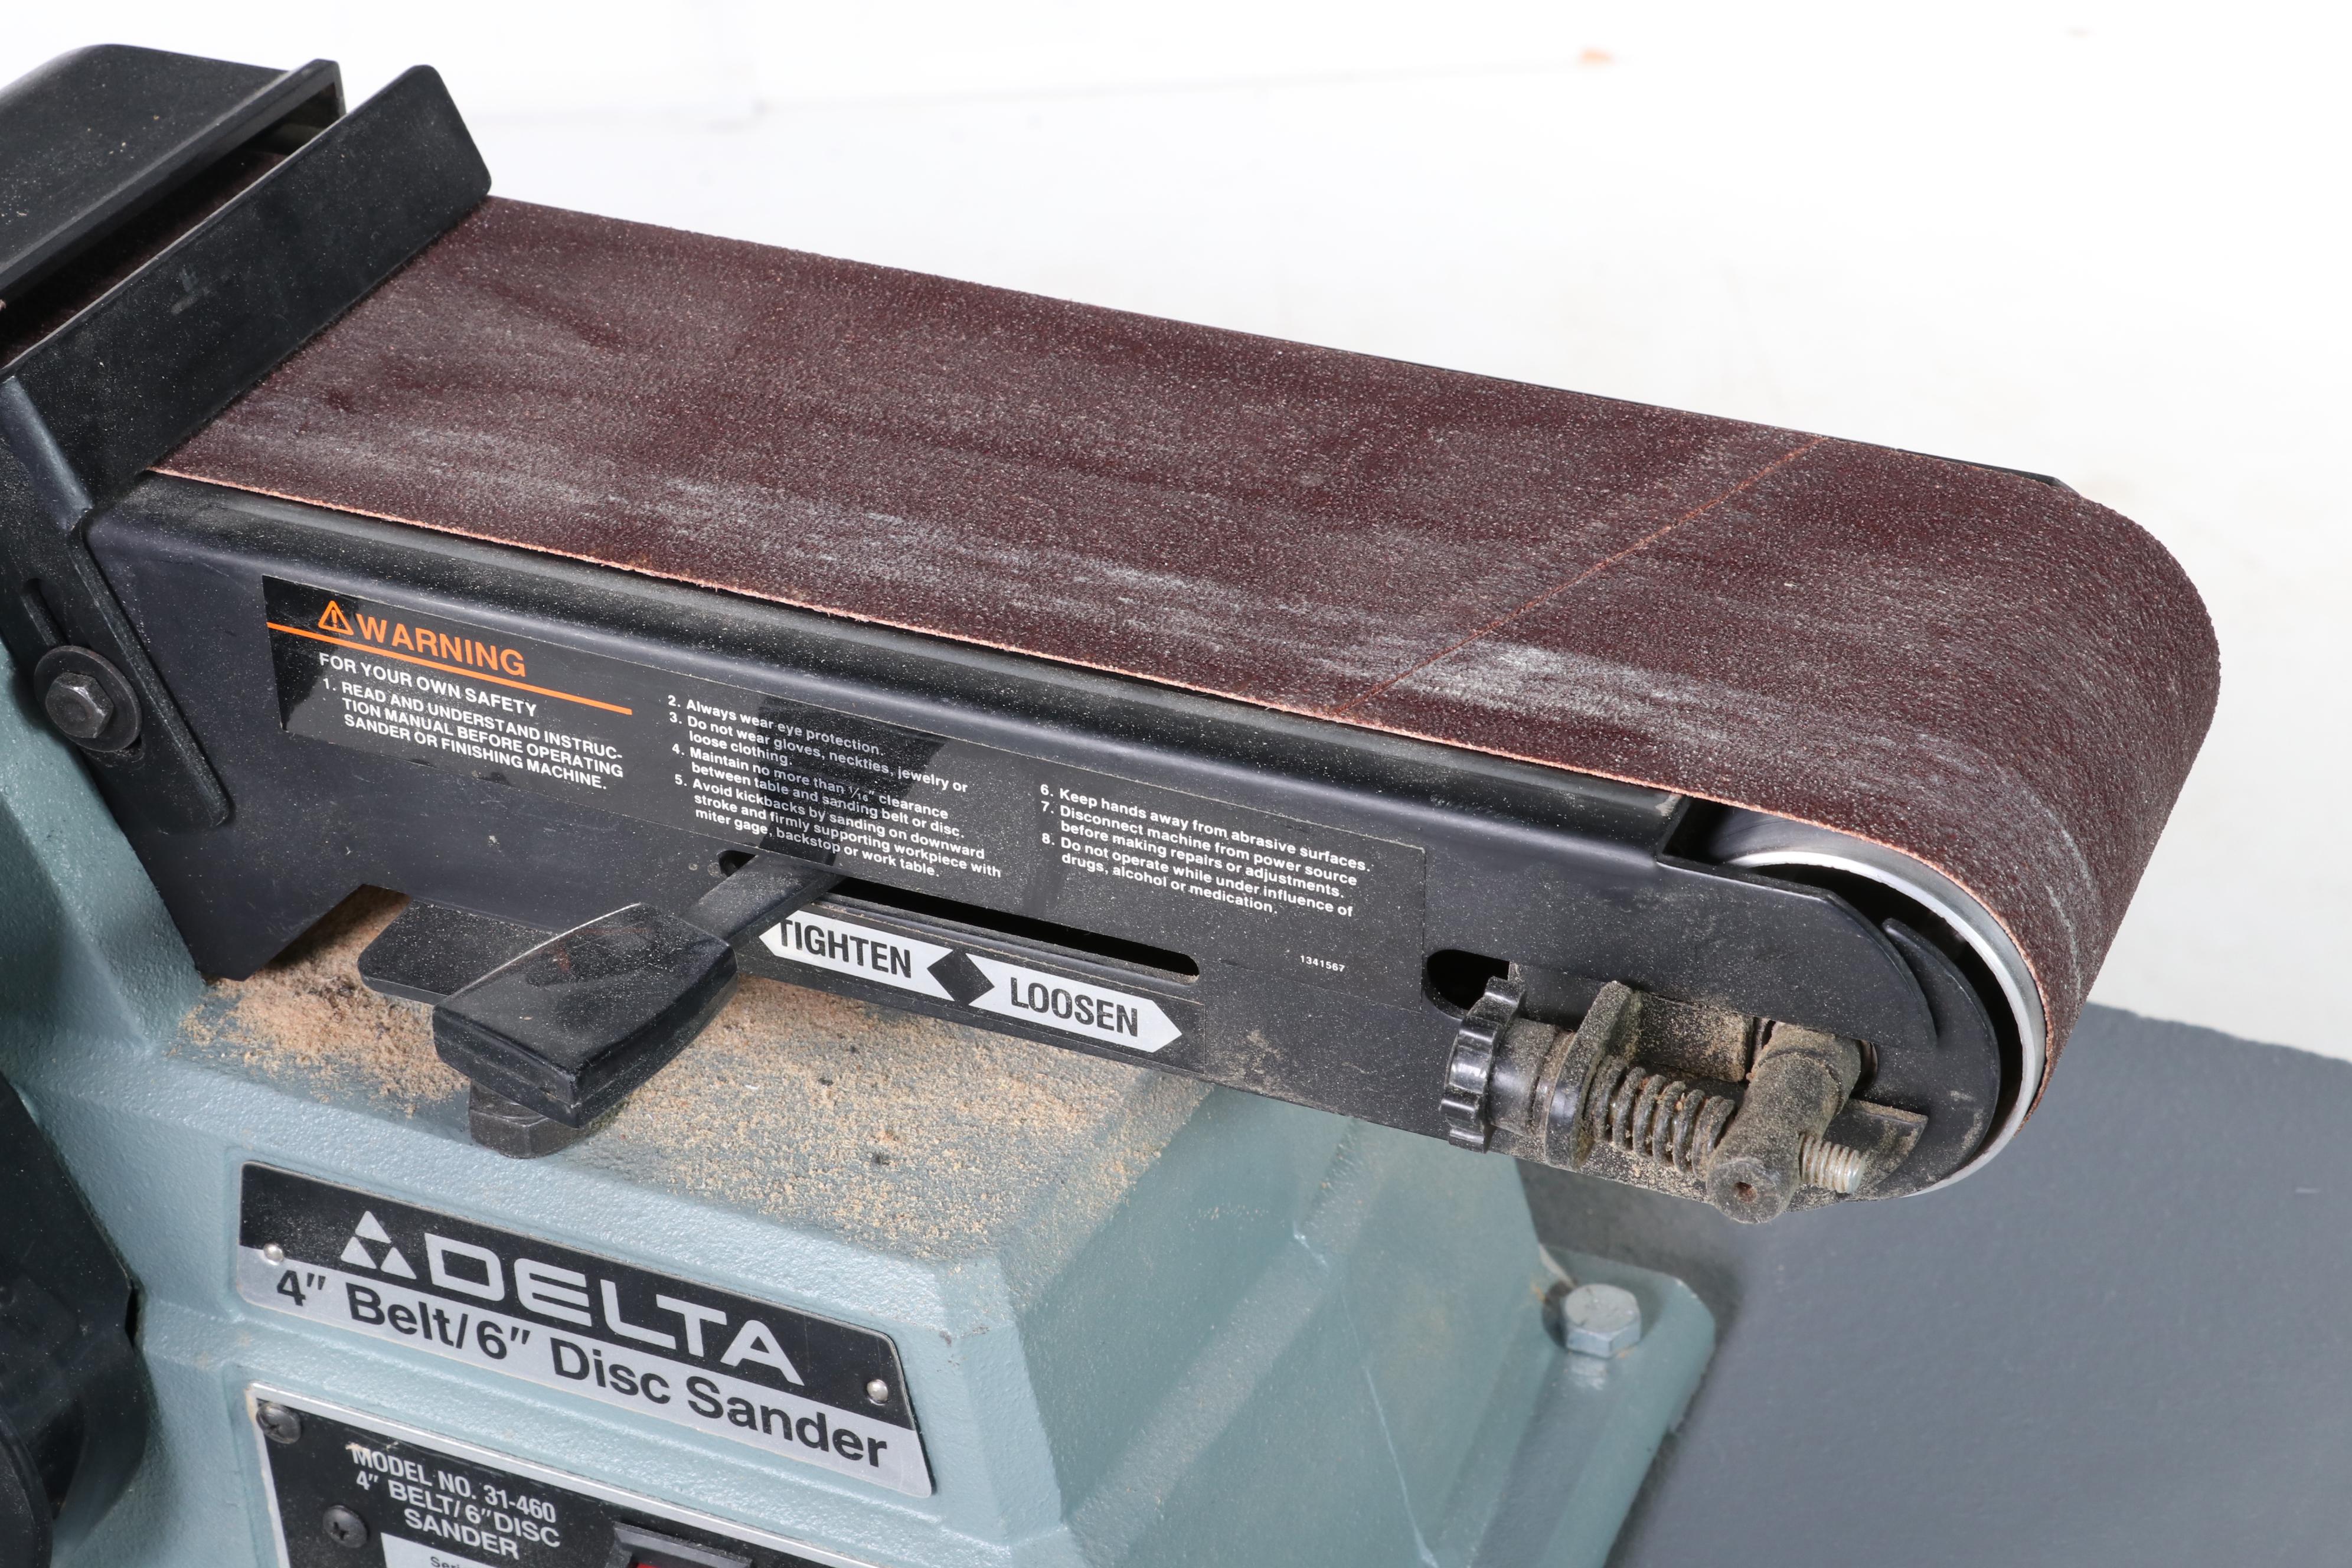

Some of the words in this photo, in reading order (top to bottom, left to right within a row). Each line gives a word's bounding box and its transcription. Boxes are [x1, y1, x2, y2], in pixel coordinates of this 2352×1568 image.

[357, 613, 525, 677] WARNING
[319, 652, 357, 674] FOR
[360, 662, 412, 687] YOUR
[416, 677, 461, 699] OWN
[465, 688, 537, 717] SAFETY
[323, 678, 336, 691] 1.
[342, 682, 386, 703] READ
[390, 694, 424, 711] AND
[428, 703, 540, 740] UNDERSTAND
[544, 730, 622, 759] INSTRUC-
[342, 697, 381, 718] TION
[385, 708, 454, 736] MANUAL
[458, 726, 524, 753] BEFORE
[527, 743, 623, 778] OPERATING
[344, 714, 410, 741] SANDER
[414, 732, 437, 748] OR
[442, 737, 523, 769] FINISHING
[527, 759, 606, 789] MACHINE.
[668, 695, 681, 707] 2.
[687, 699, 737, 721] Always
[740, 713, 773, 729] wear
[778, 723, 802, 736] eye
[806, 729, 884, 756] protection.
[669, 711, 682, 724] 3.
[687, 716, 707, 729] Do
[710, 723, 733, 736] not
[737, 729, 770, 744] wear
[774, 737, 825, 760] gloves,
[829, 750, 894, 776] neckties,
[898, 766, 949, 790] jewelry
[952, 781, 968, 792] or
[689, 730, 727, 750] loose
[731, 740, 792, 766] clothing.
[672, 743, 684, 756] 4.
[690, 746, 749, 770] Maintain
[753, 763, 770, 776] no
[774, 769, 809, 786] more
[814, 777, 844, 794] than
[878, 794, 948, 819] clearance
[675, 774, 687, 786] 5.
[692, 779, 732, 798] Avoid
[736, 788, 805, 815] kickbacks
[809, 806, 826, 822] by
[829, 813, 885, 837] sanding
[889, 828, 907, 840] on
[910, 832, 985, 860] downward
[692, 762, 750, 786] between
[754, 778, 789, 795] table
[793, 787, 818, 802] and
[822, 794, 877, 819] sanding
[881, 808, 909, 825] belt
[912, 816, 927, 828] or
[930, 821, 964, 838] disc.
[694, 794, 737, 813] stroke
[741, 806, 766, 820] and
[770, 811, 809, 832] firmly
[814, 824, 890, 852] supporting
[894, 844, 967, 870] workpiece
[971, 861, 1001, 878] with
[695, 808, 731, 825] miter
[734, 819, 772, 837] gage,
[776, 828, 840, 854] backstop
[844, 845, 858, 857] or
[862, 850, 896, 867] work
[900, 858, 939, 877] table.
[1040, 784, 1053, 796] 6.
[1060, 788, 1097, 809] Keep
[1102, 798, 1146, 819] hands
[1150, 812, 1188, 831] away
[1193, 819, 1227, 838] from
[1231, 831, 1296, 854] abrasive
[1299, 847, 1370, 872] surfaces.
[1041, 801, 1054, 814] 7.
[1060, 805, 1144, 835] Disconnect
[1144, 828, 1211, 851] machine
[1214, 842, 1249, 860] from
[1253, 853, 1301, 872] power
[1305, 865, 1357, 886] source
[1061, 820, 1109, 841] before
[1112, 834, 1167, 858] making
[1171, 848, 1223, 869] repairs
[1226, 863, 1242, 873] or
[1245, 867, 1344, 898] adjustments.
[1042, 833, 1055, 845] 8.
[1061, 837, 1081, 851] Do
[1084, 844, 1108, 859] not
[1112, 851, 1169, 873] operate
[1173, 867, 1212, 883] while
[1216, 876, 1260, 894] under
[1263, 886, 1334, 913] influence
[1337, 906, 1353, 917] of
[1062, 853, 1109, 875] drugs,
[1113, 866, 1167, 887] alcohol
[1171, 880, 1186, 891] or
[1190, 885, 1278, 914] medication.
[780, 919, 912, 978] TIGHTEN
[1300, 955, 1345, 972] 1341567
[1010, 976, 1138, 1037] LOOSEN
[424, 1232, 805, 1386] DELTA
[277, 1270, 326, 1306] 4"
[550, 1337, 670, 1403] Disc
[687, 1376, 887, 1467] Sander
[351, 1445, 433, 1487] MODEL
[438, 1471, 476, 1499] NO.
[484, 1484, 556, 1524] 31-460
[356, 1471, 378, 1491] 4"
[404, 1508, 520, 1560] SANDER
